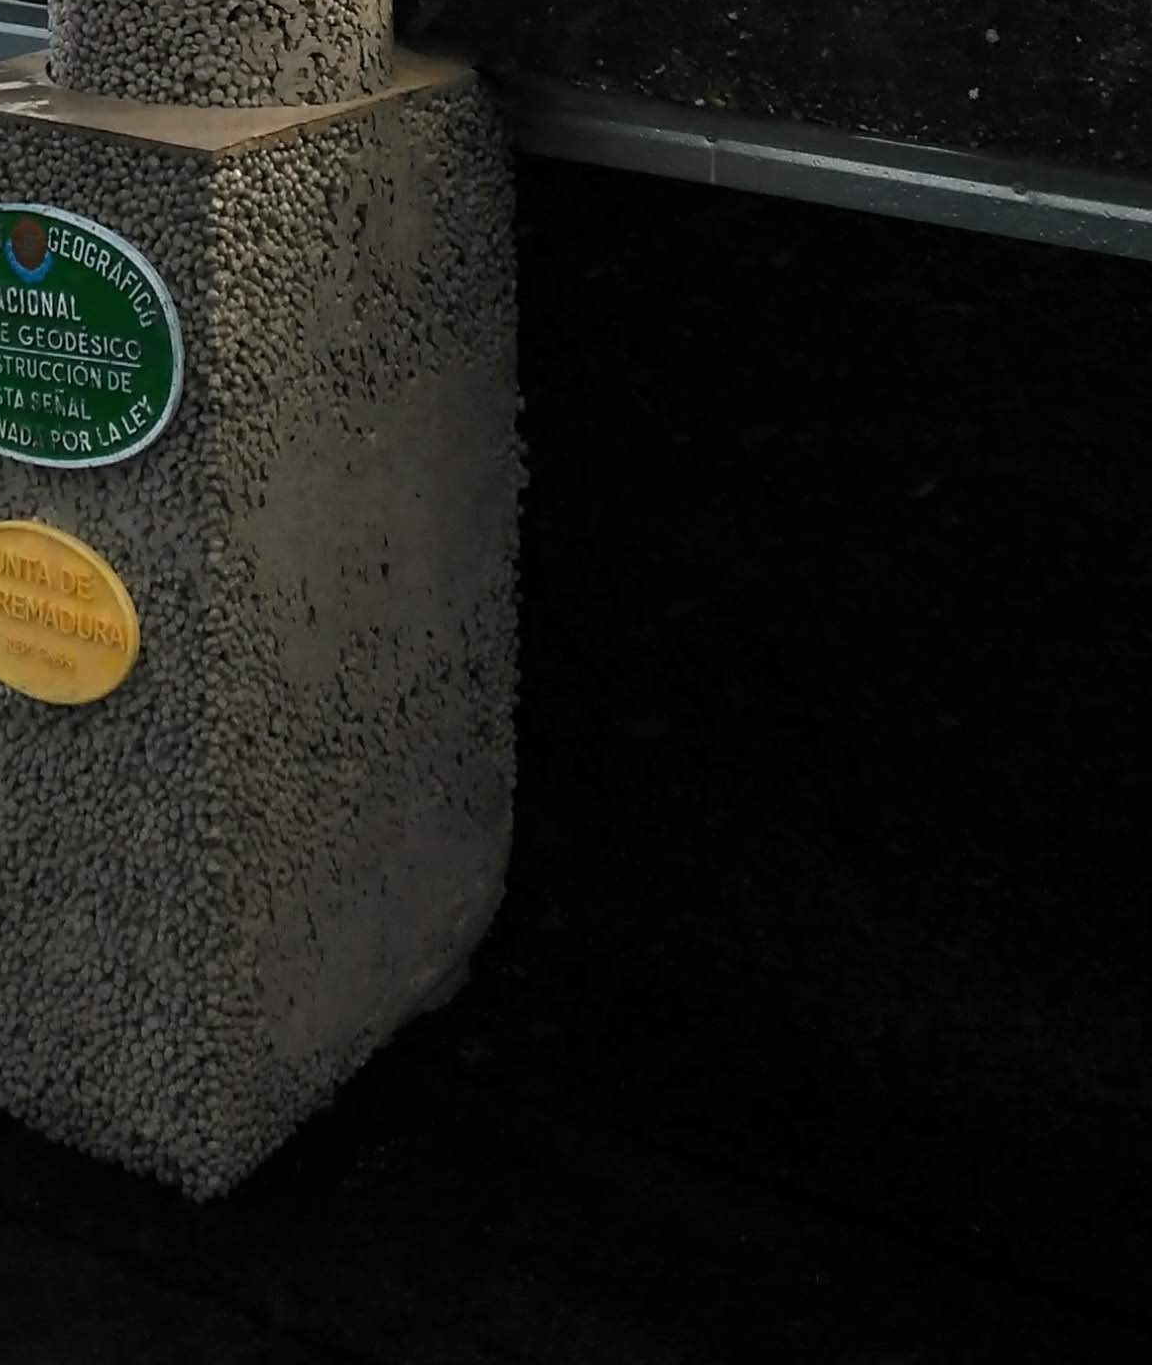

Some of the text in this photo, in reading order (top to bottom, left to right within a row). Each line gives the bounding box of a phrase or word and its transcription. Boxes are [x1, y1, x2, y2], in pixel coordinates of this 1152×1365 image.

[47, 226, 158, 329] GEOGRÁFICO
[17, 324, 142, 361] GEODÉSICO
[107, 369, 133, 395] DE
[50, 427, 93, 453] POR
[95, 421, 123, 447] LA
[120, 394, 155, 436] LEY
[59, 568, 95, 602] DE
